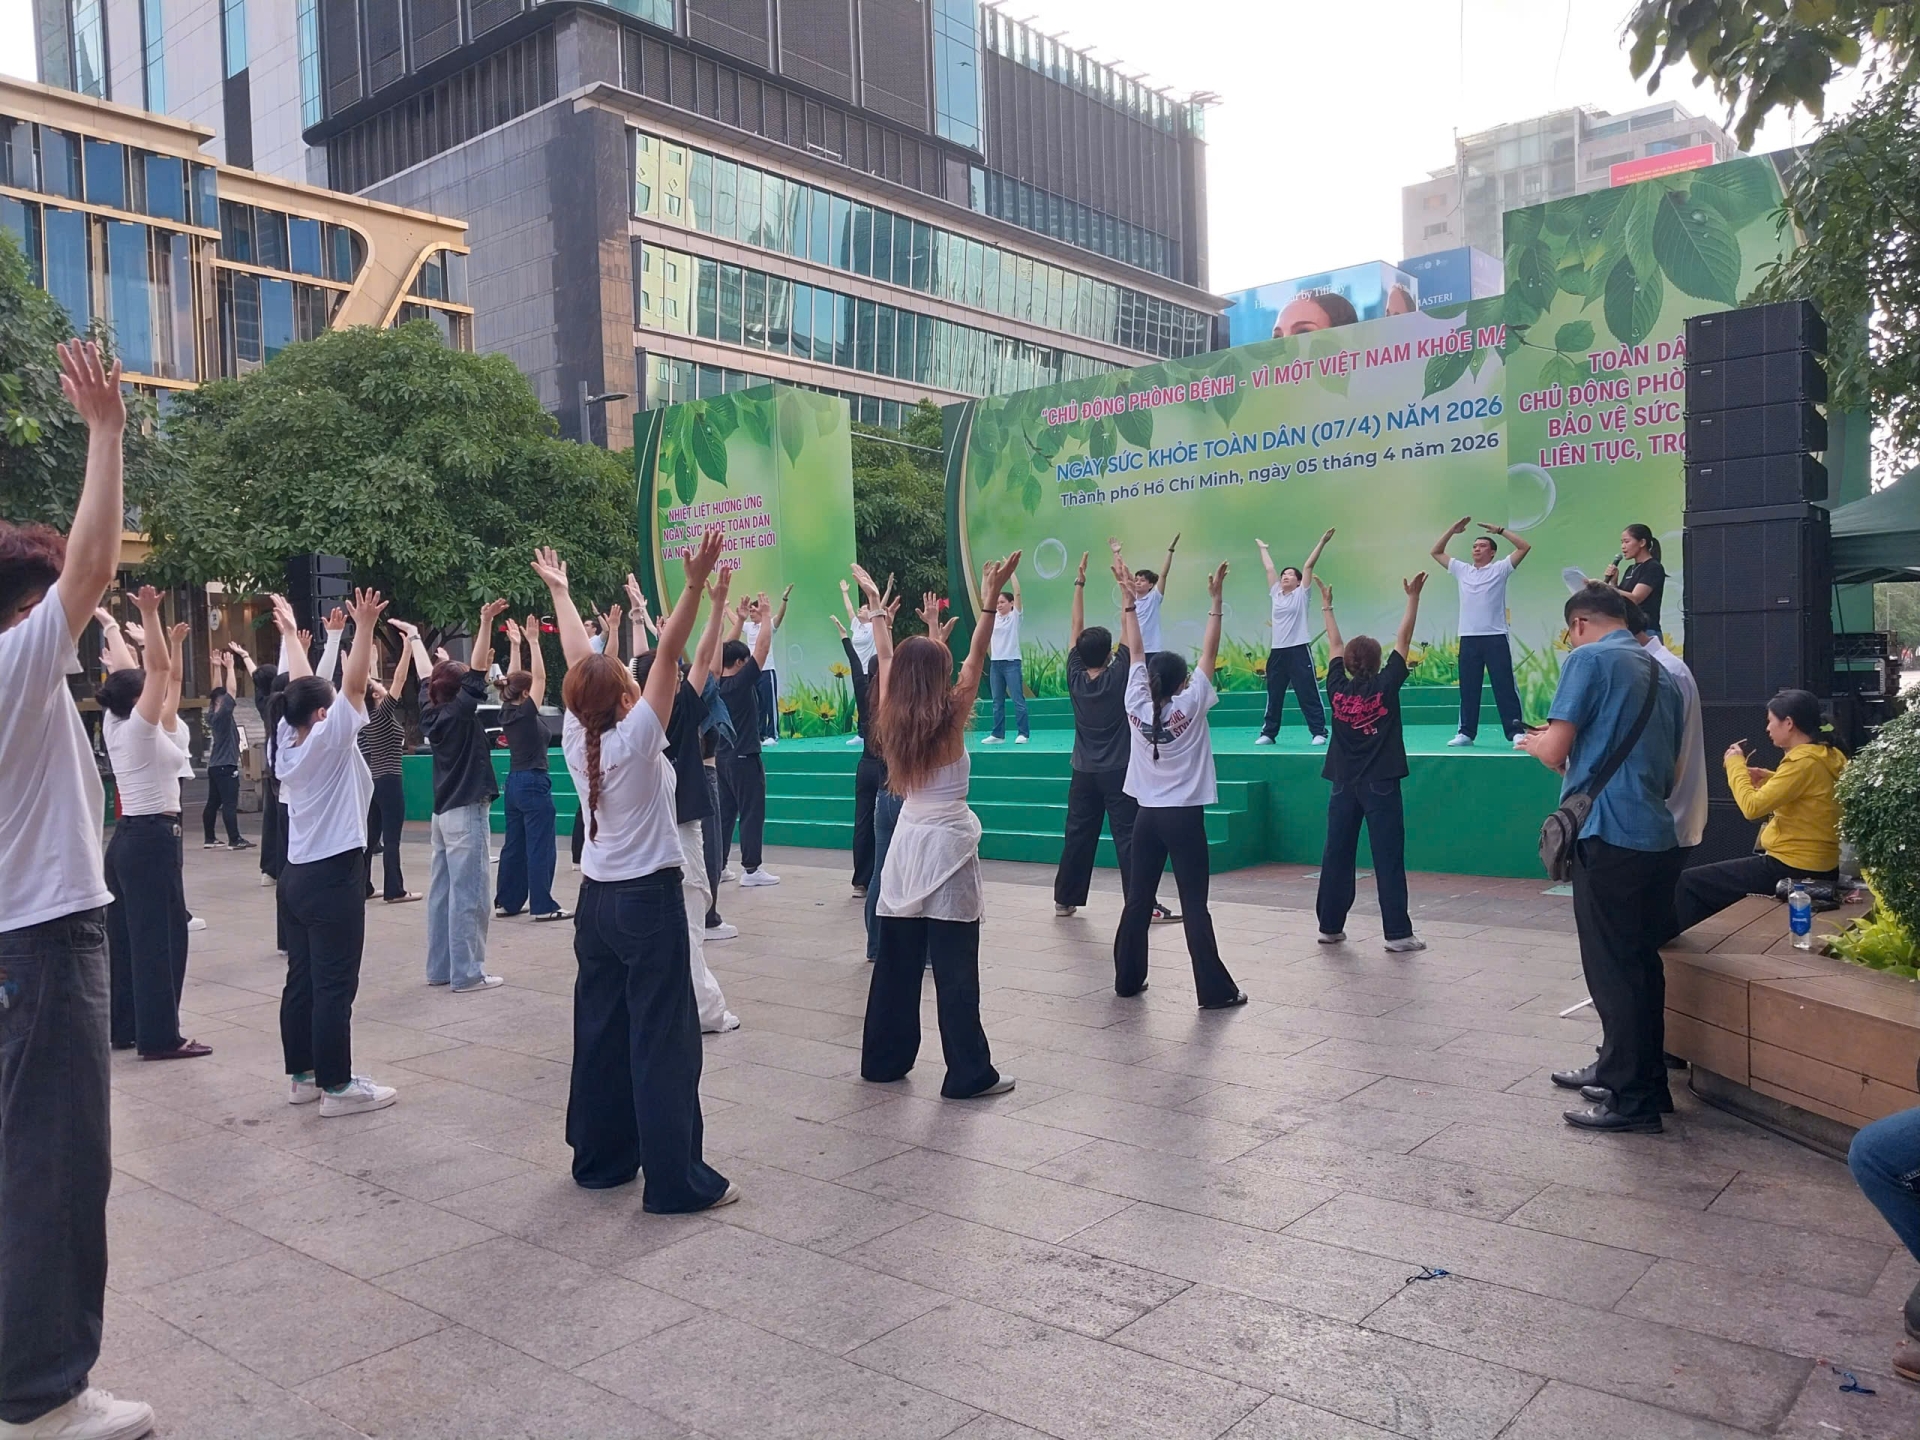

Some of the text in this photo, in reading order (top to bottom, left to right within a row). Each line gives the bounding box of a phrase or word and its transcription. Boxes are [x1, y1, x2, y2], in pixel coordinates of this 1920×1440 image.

[1302, 290, 1313, 302] by
[1588, 343, 1650, 374] TOÀN
[1082, 396, 1126, 422] ĐỘNG
[1128, 385, 1186, 411] PHÒNG
[1190, 374, 1236, 402] BỆNH
[1252, 366, 1270, 390] VÌ
[1274, 357, 1316, 386] MỘT
[1319, 350, 1361, 378] VIỆT
[1366, 342, 1412, 369] NAM
[1417, 328, 1473, 360] KHỎE
[1519, 382, 1563, 413] CHỦ
[1567, 378, 1631, 408] ĐỘNG
[1548, 399, 1681, 438] BẢO VỆ SỨC
[1057, 395, 1504, 483] NGÀY SỨC KHỎE TOÀN DÂN (07/4) NĂM 2026
[1540, 442, 1586, 468] LIÊN
[1591, 437, 1642, 465] TỤC,
[1061, 432, 1500, 507] Thành phố Hồ Chí Minh, ngày 05 tháng 4 năm 2026
[668, 494, 763, 522] NHIỆT LIỆT HƯỞNG ỨNG
[663, 524, 685, 542] NGÀY
[686, 522, 703, 538] SỨC
[727, 514, 752, 532] TOÀN
[752, 511, 771, 529] DÂN
[662, 545, 674, 561] VÀ
[719, 534, 739, 553] HỎE
[739, 530, 757, 550] THẾ
[757, 529, 777, 549] GIỚI
